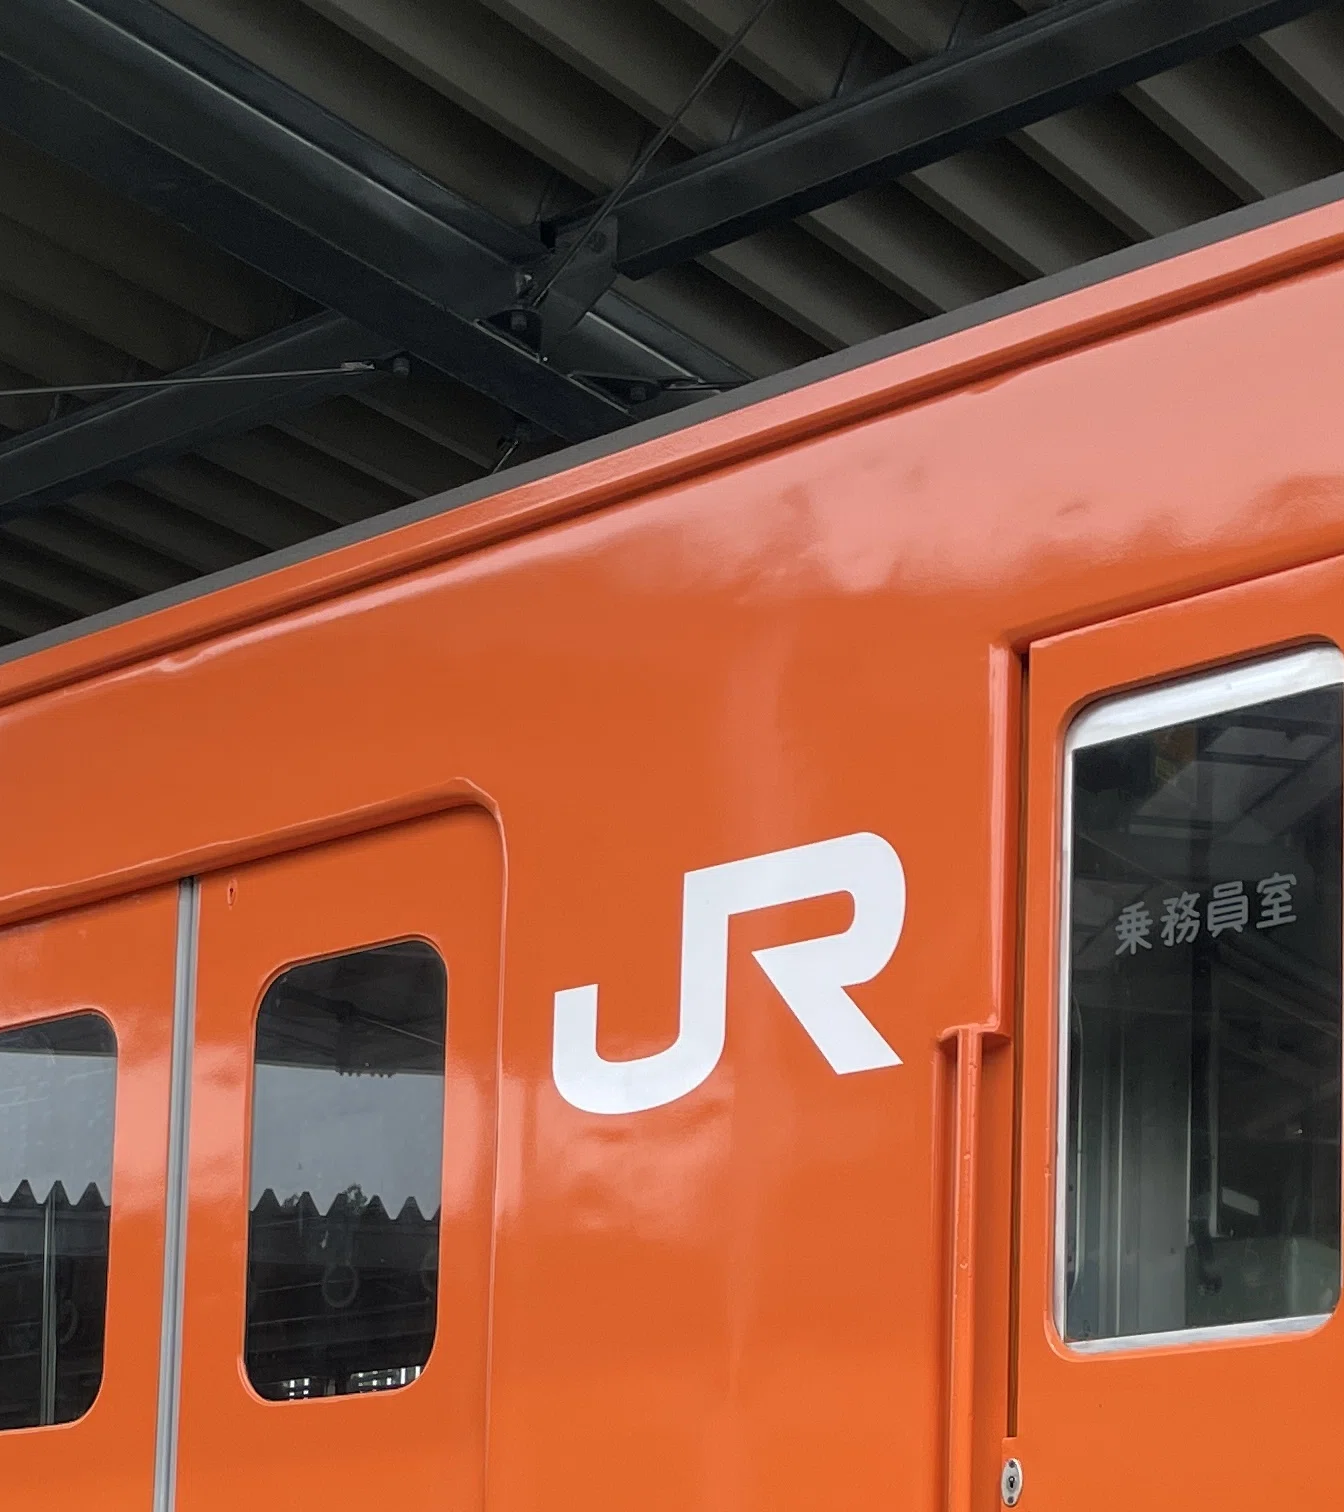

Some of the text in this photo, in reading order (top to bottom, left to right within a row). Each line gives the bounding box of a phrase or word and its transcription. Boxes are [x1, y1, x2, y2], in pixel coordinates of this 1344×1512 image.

[552, 832, 906, 1115] JR
[1115, 872, 1297, 955] 乗務員室
